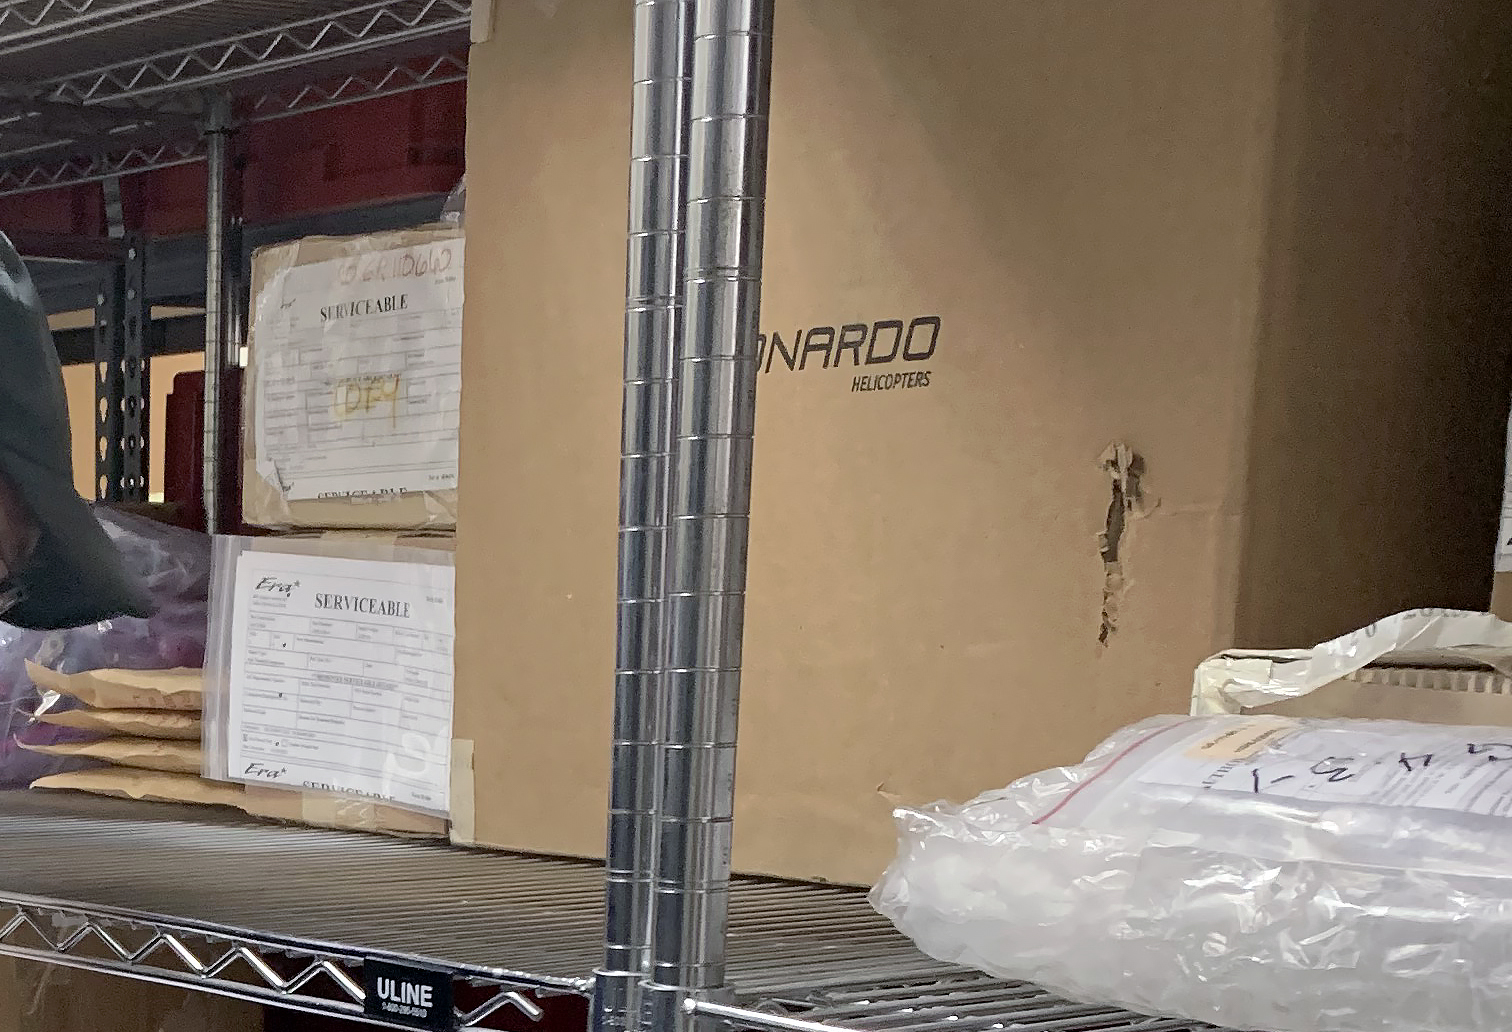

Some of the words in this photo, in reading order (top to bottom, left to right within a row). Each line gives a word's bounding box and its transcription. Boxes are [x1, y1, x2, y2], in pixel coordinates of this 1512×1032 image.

[319, 294, 409, 322] SERVICEABLE
[758, 316, 941, 373] NARDO
[852, 371, 931, 392] HELICOPTERS
[314, 592, 410, 618] SERVICEABLE
[377, 977, 433, 1007] ULINE
